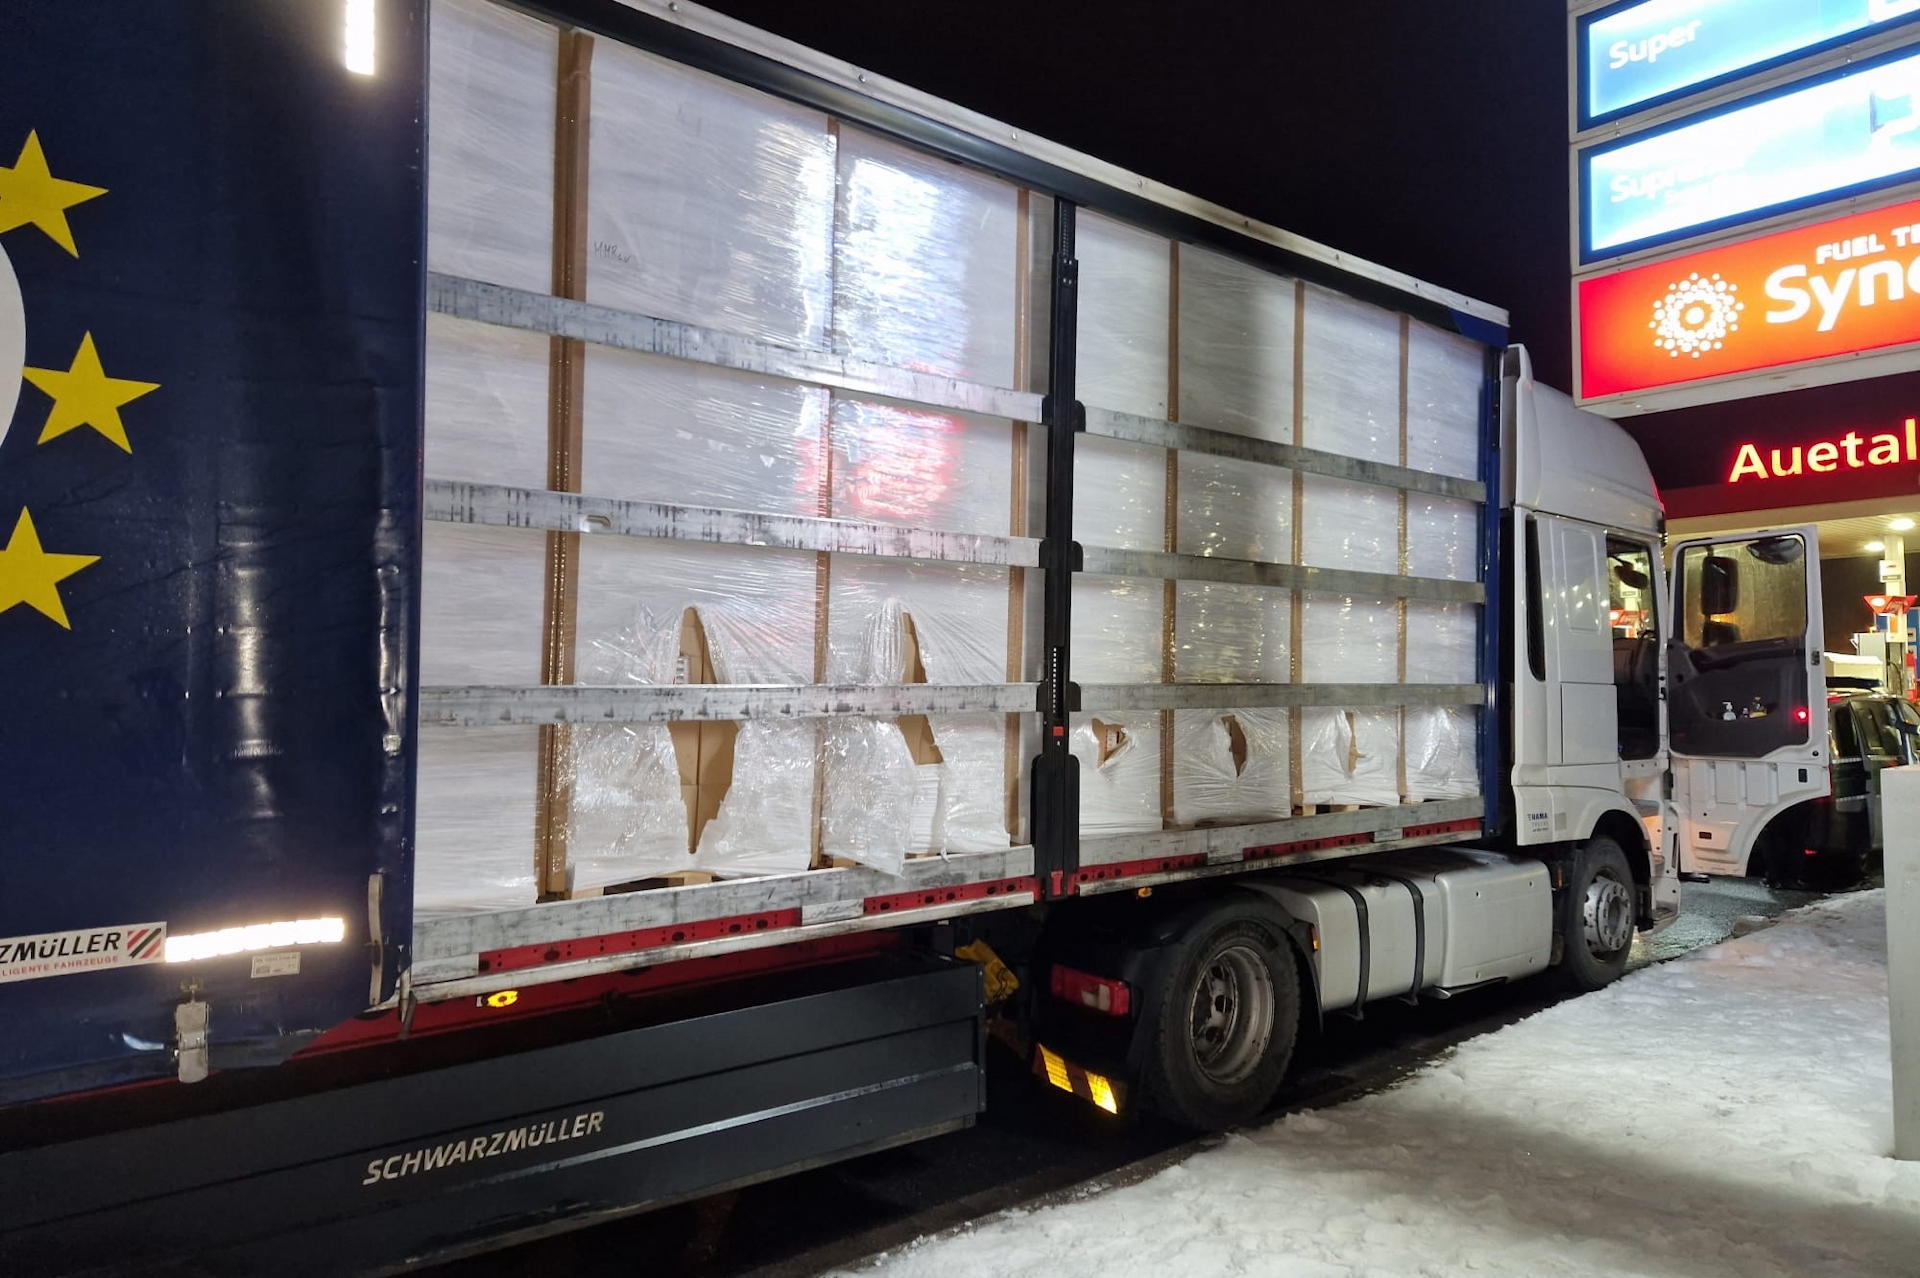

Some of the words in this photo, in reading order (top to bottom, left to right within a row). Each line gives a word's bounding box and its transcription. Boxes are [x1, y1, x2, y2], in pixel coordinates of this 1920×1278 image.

[1609, 20, 1702, 69] Super
[1816, 233, 1886, 265] FUEL
[1729, 418, 1917, 483] Auetal
[2, 965, 50, 977] LIGENTE
[54, 955, 119, 969] FAHRZEUGE
[362, 1111, 605, 1185] SCHWARZMÜLLER
